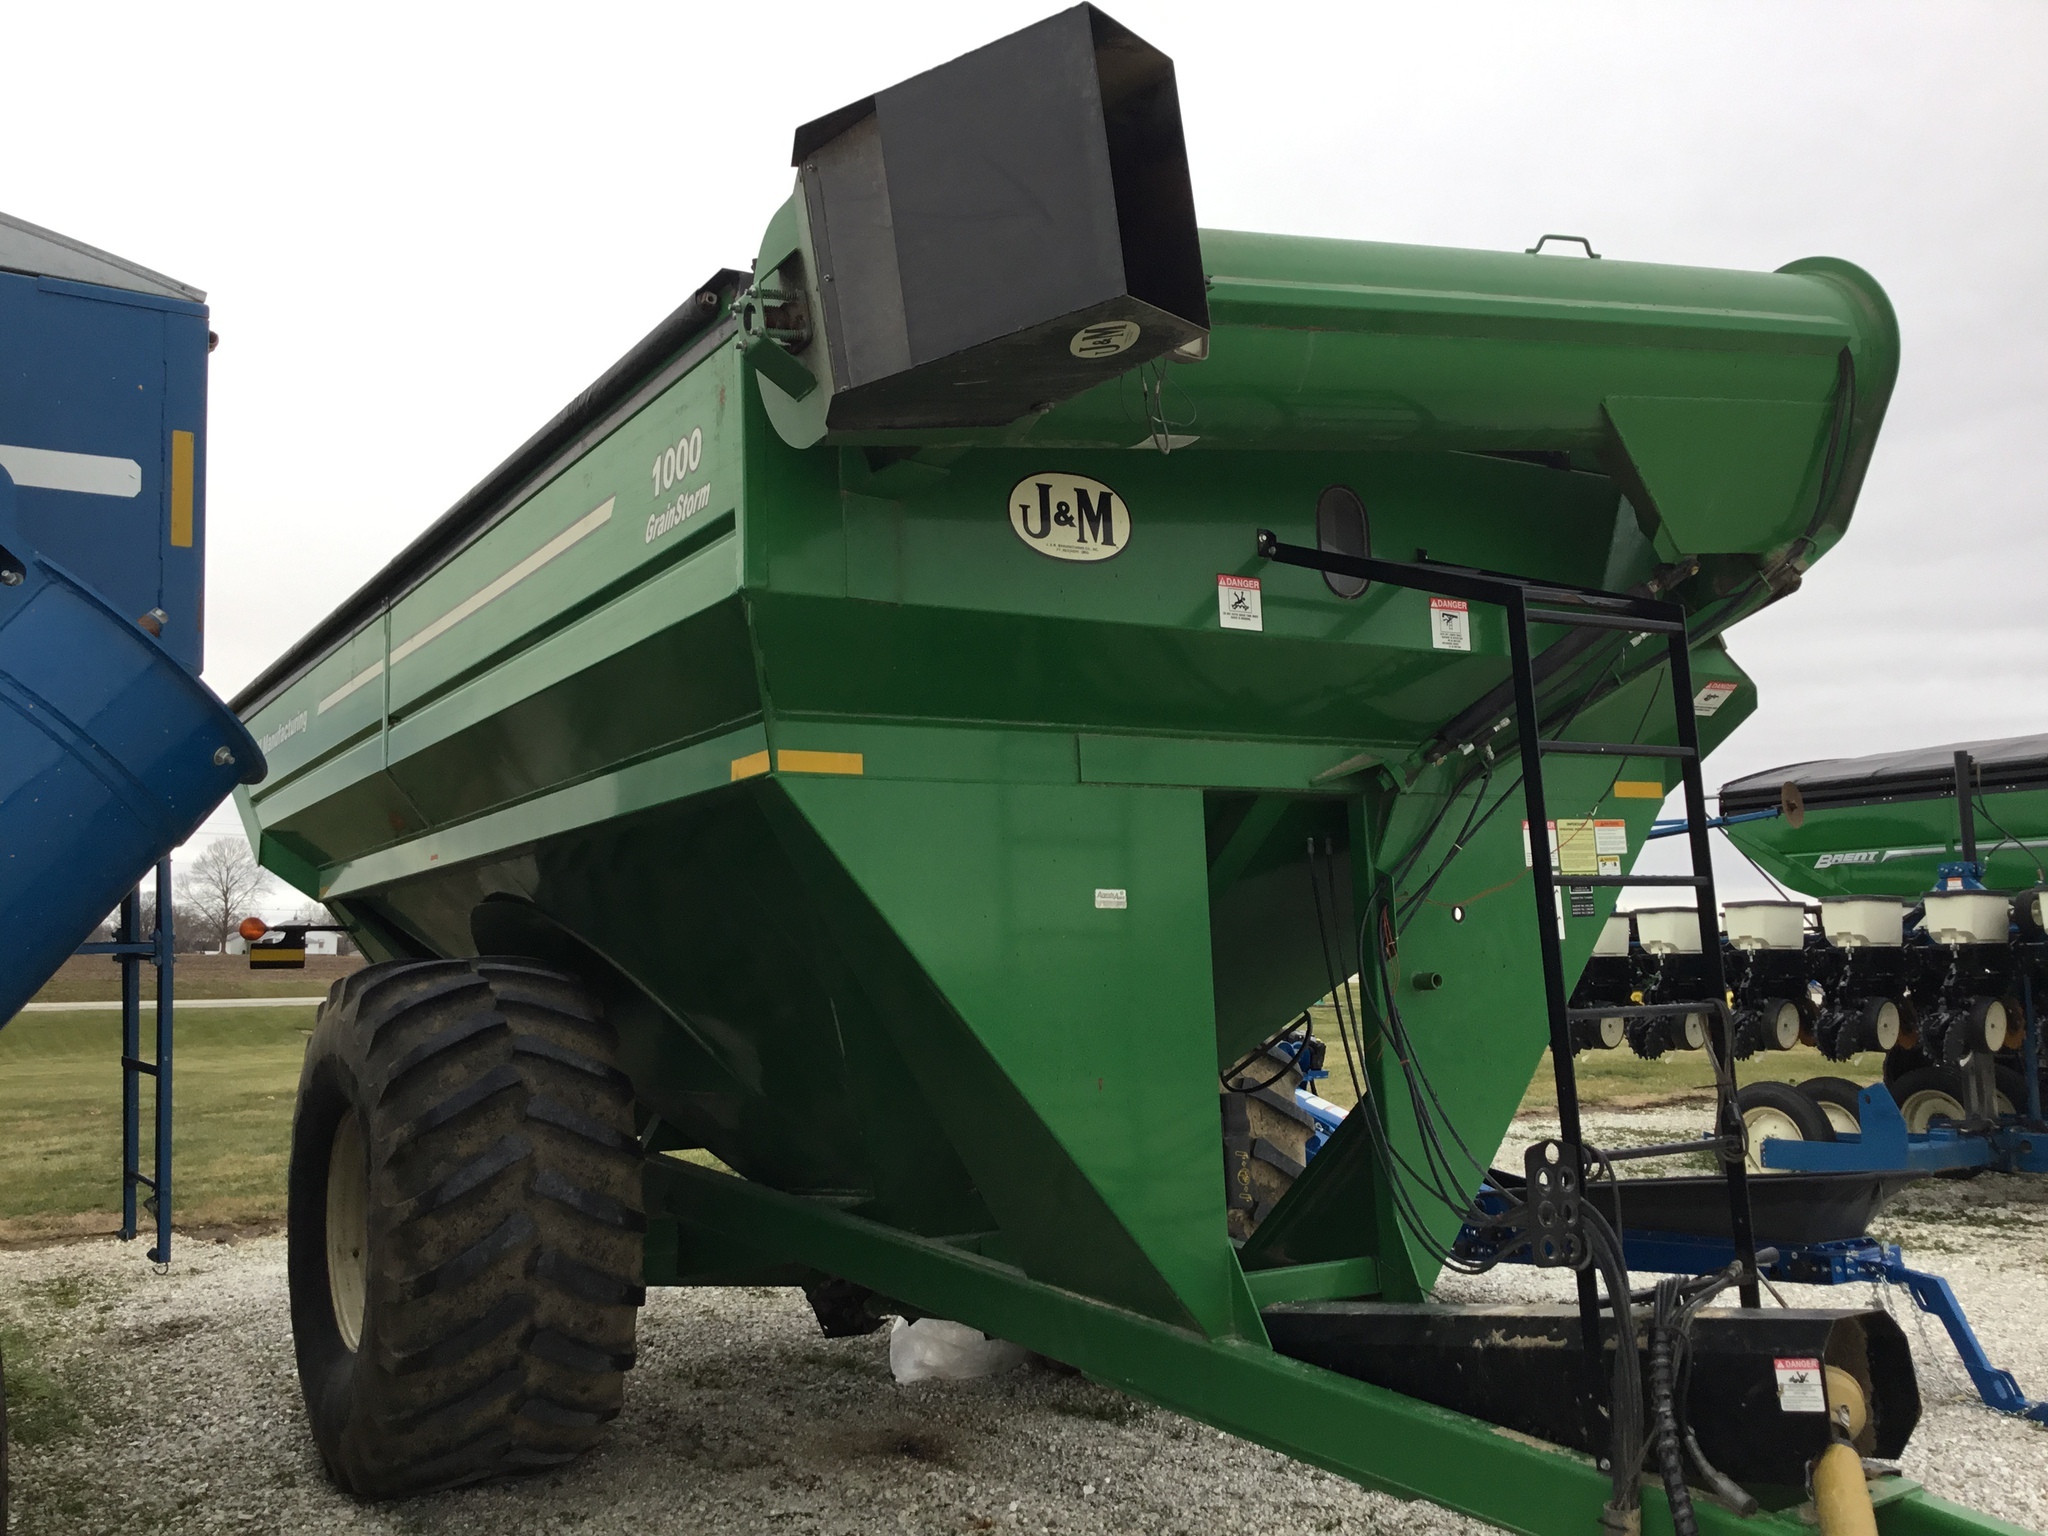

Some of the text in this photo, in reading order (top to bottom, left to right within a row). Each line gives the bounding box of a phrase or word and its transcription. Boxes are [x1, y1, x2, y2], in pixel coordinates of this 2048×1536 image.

[652, 427, 702, 498] 1000
[645, 482, 711, 544] GrainStorm
[1018, 482, 1117, 547] J&M
[1226, 577, 1260, 589] DANGER
[1437, 599, 1468, 610] DANGER
[1785, 1360, 1818, 1368] DANGER
